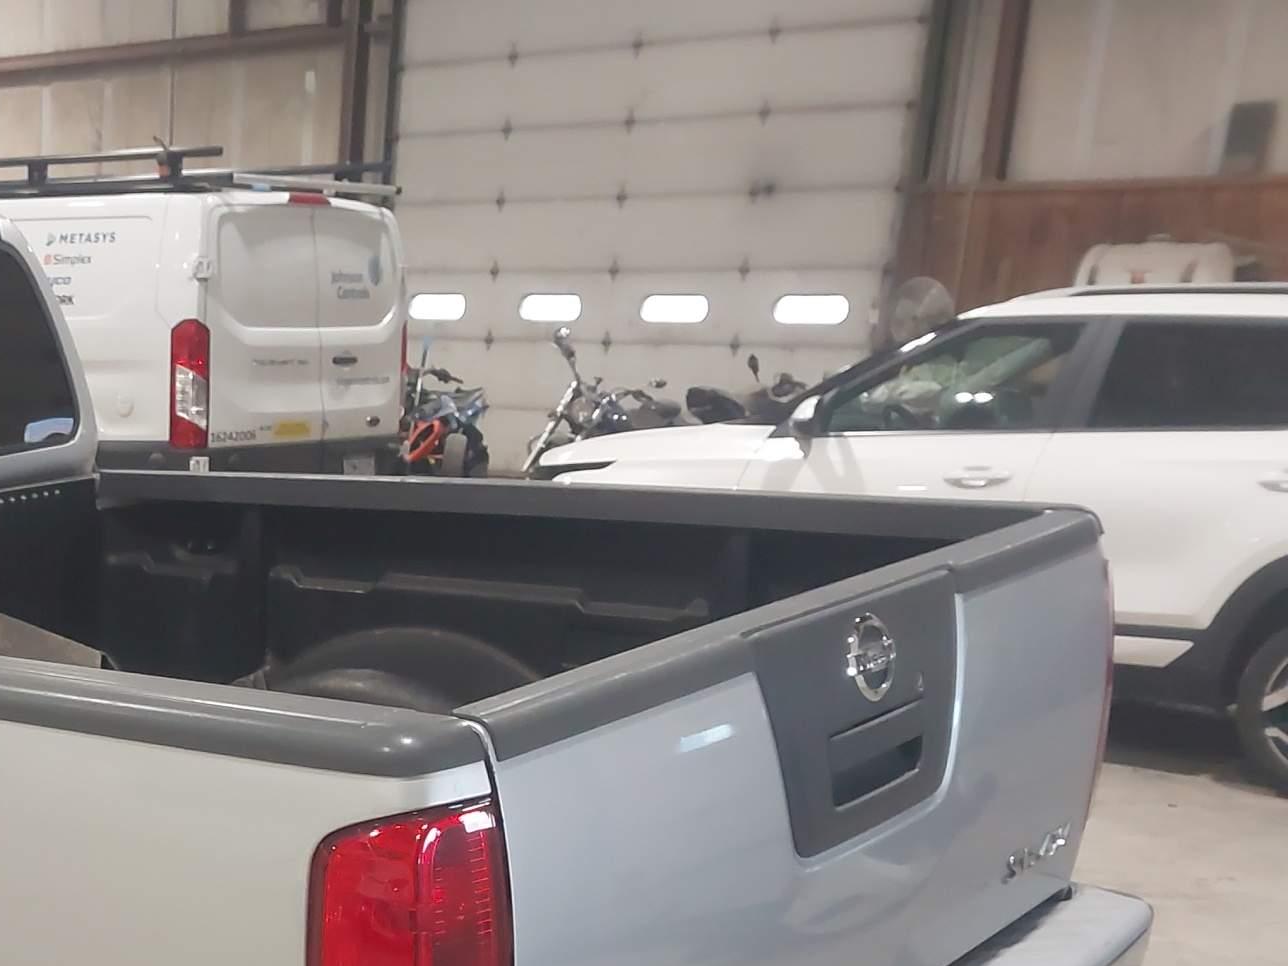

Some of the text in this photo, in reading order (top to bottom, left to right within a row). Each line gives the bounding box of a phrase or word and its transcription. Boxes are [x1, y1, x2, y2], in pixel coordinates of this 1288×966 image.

[58, 231, 116, 245] METASYS
[53, 253, 92, 267] Simplex
[47, 276, 72, 288] yco
